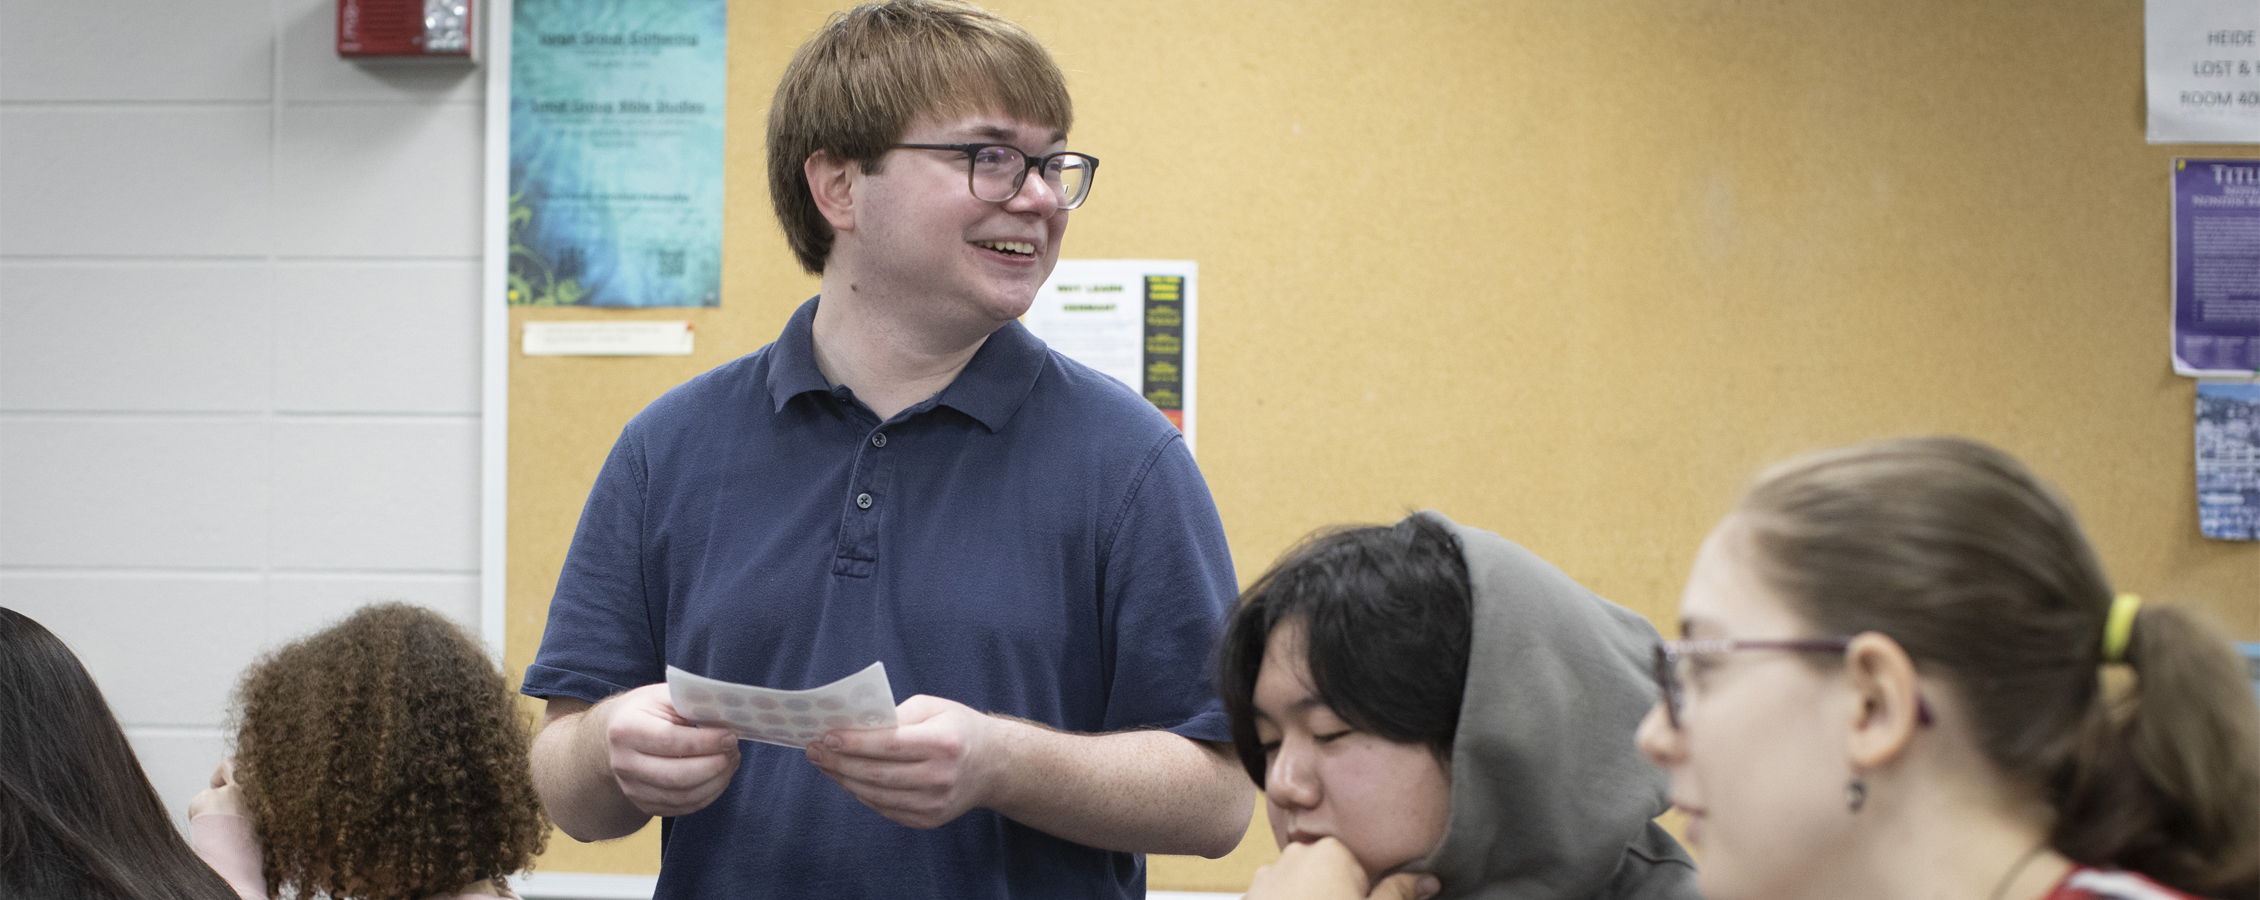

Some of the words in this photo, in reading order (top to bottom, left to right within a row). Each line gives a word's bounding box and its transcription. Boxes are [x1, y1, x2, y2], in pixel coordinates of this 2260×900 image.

[2208, 30, 2256, 46] HEIDE
[2193, 60, 2232, 77] LOST
[2238, 60, 2251, 77] &
[2180, 90, 2233, 107] ROOM
[2210, 164, 2260, 185] TITL
